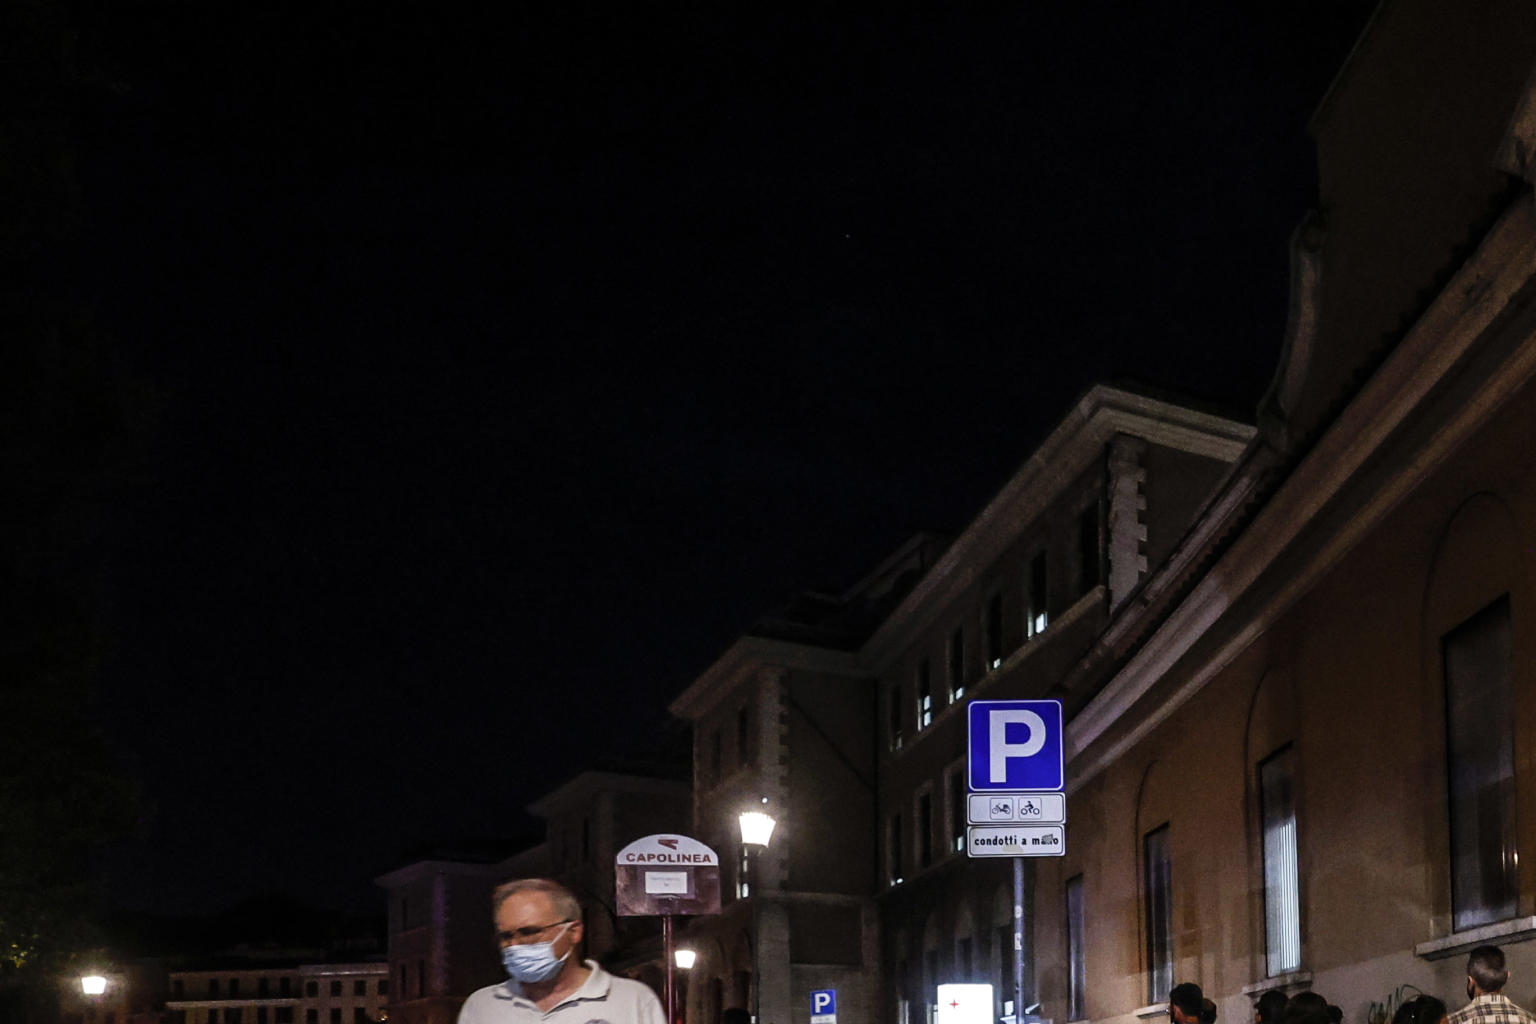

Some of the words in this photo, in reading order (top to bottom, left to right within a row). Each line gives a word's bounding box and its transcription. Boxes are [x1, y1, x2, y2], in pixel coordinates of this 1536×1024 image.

[989, 709, 1047, 784] P
[974, 835, 1017, 846] condotti
[1031, 837, 1059, 846] mao
[625, 852, 712, 863] CAPOLINEA
[814, 992, 831, 1014] P
